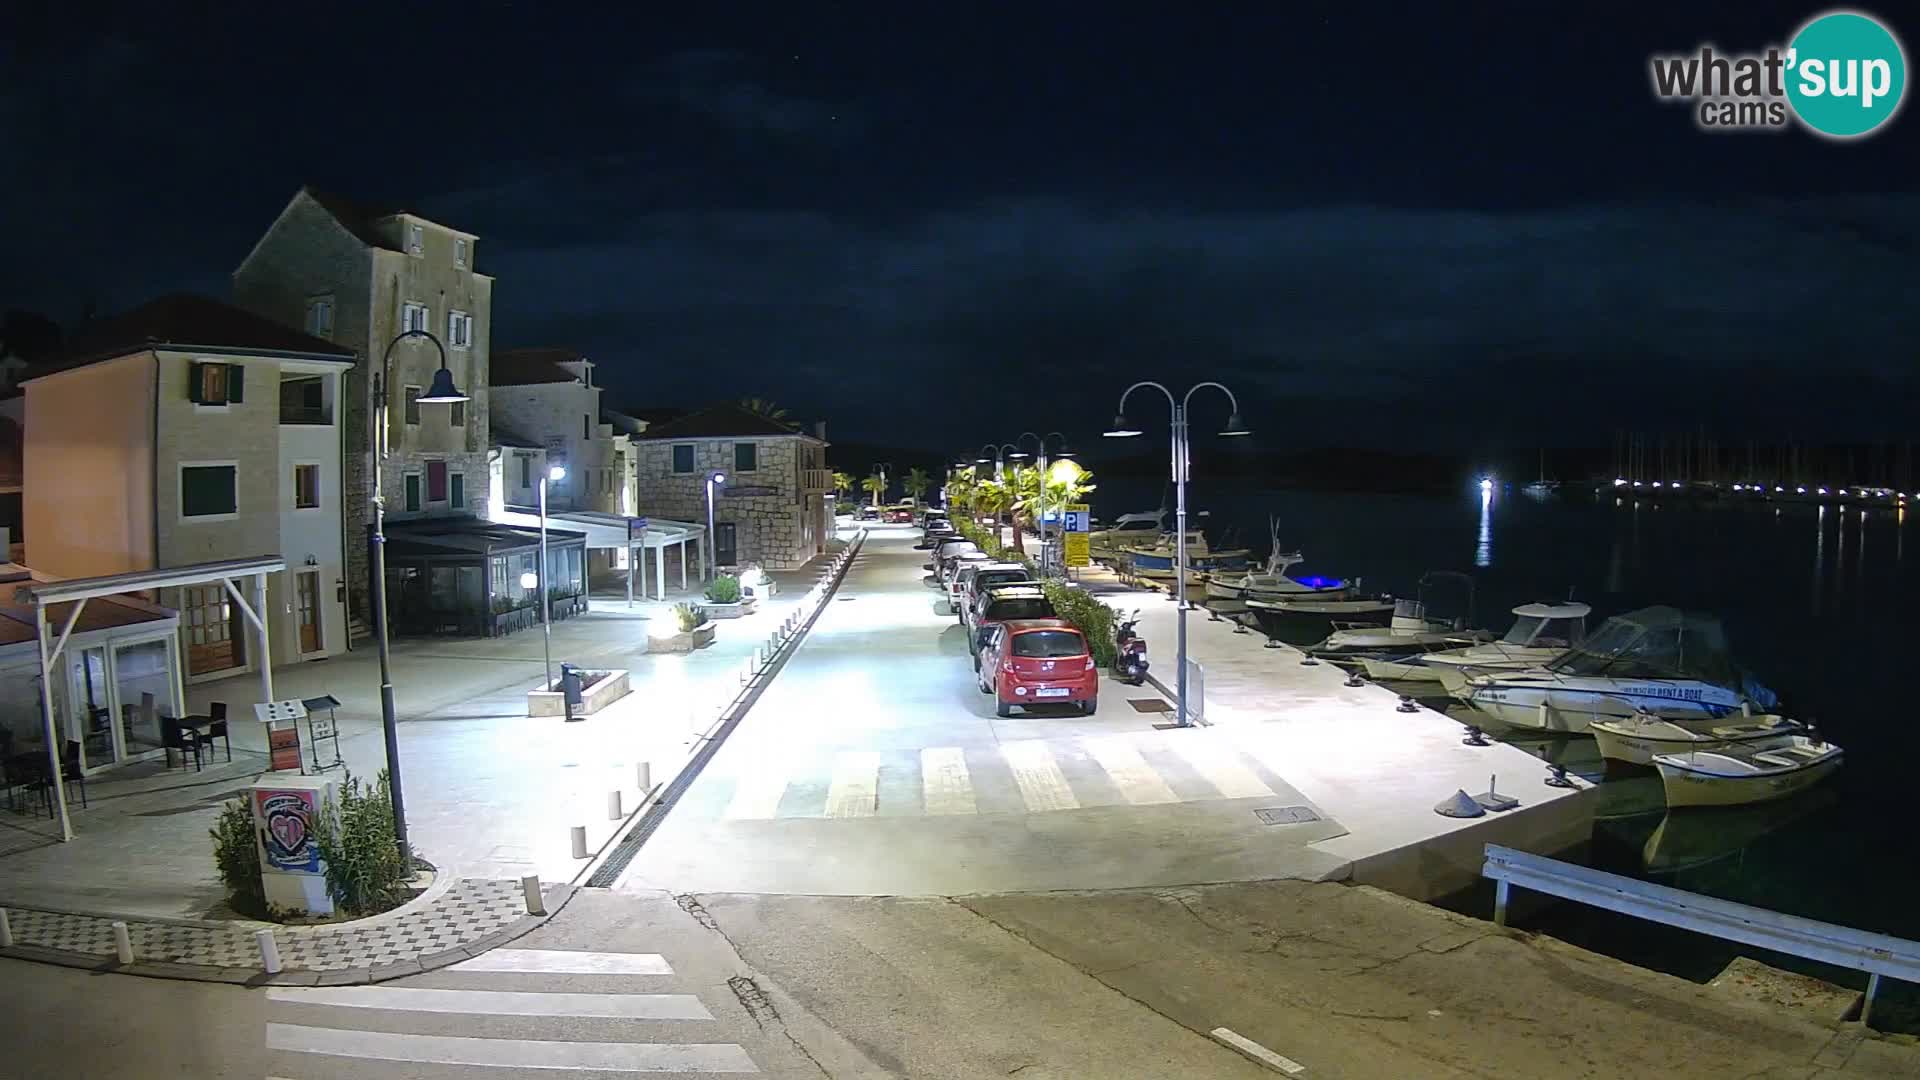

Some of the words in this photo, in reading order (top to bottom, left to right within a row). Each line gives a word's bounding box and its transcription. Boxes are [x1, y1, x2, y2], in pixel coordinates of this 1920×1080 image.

[1066, 514, 1077, 530] P
[1657, 687, 1677, 697] RENT
[1677, 688, 1683, 697] A
[1684, 689, 1702, 700] BOAT
